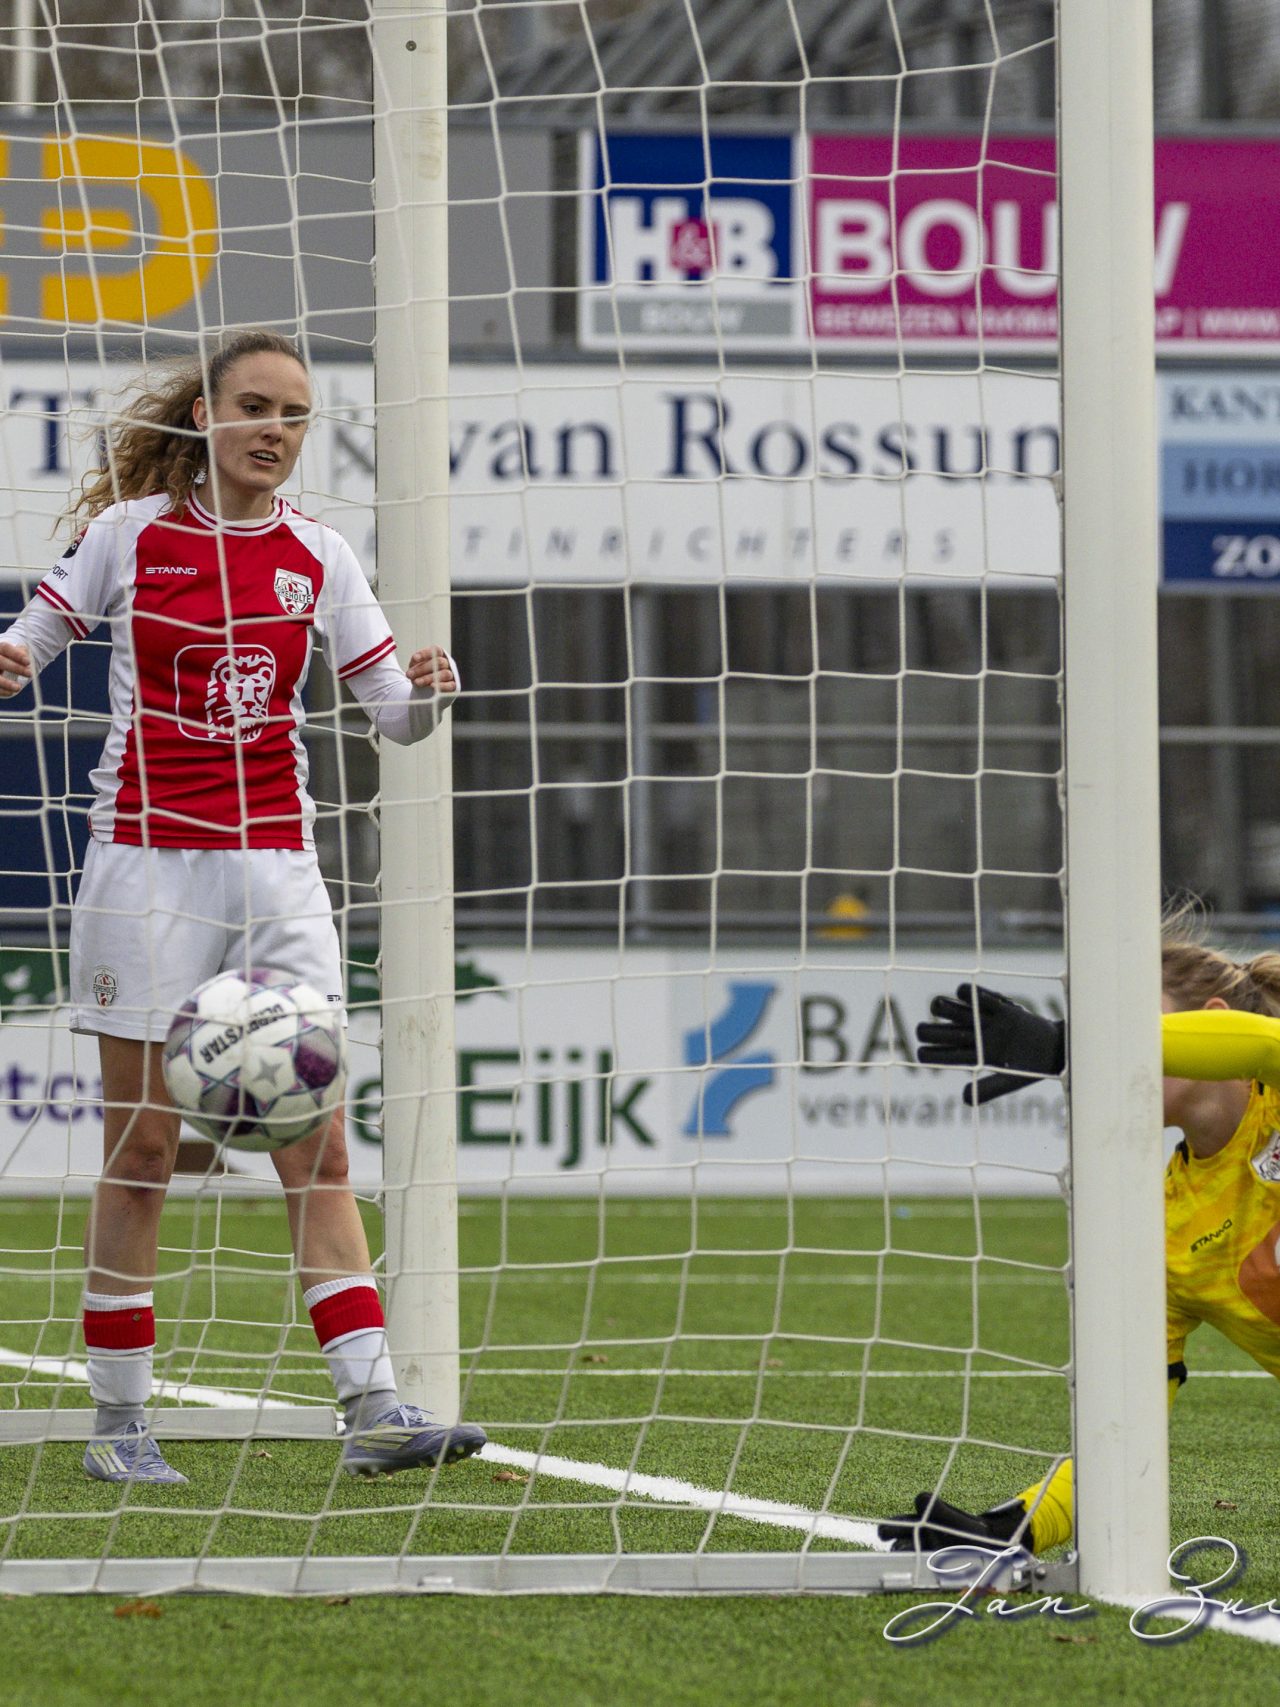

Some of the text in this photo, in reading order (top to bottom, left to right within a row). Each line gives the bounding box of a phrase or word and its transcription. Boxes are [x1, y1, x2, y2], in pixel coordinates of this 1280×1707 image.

[608, 197, 780, 287] H&B
[815, 199, 1189, 297] BOU
[449, 418, 618, 479] van
[145, 567, 198, 576] STANNO
[458, 1047, 656, 1169] Eijk
